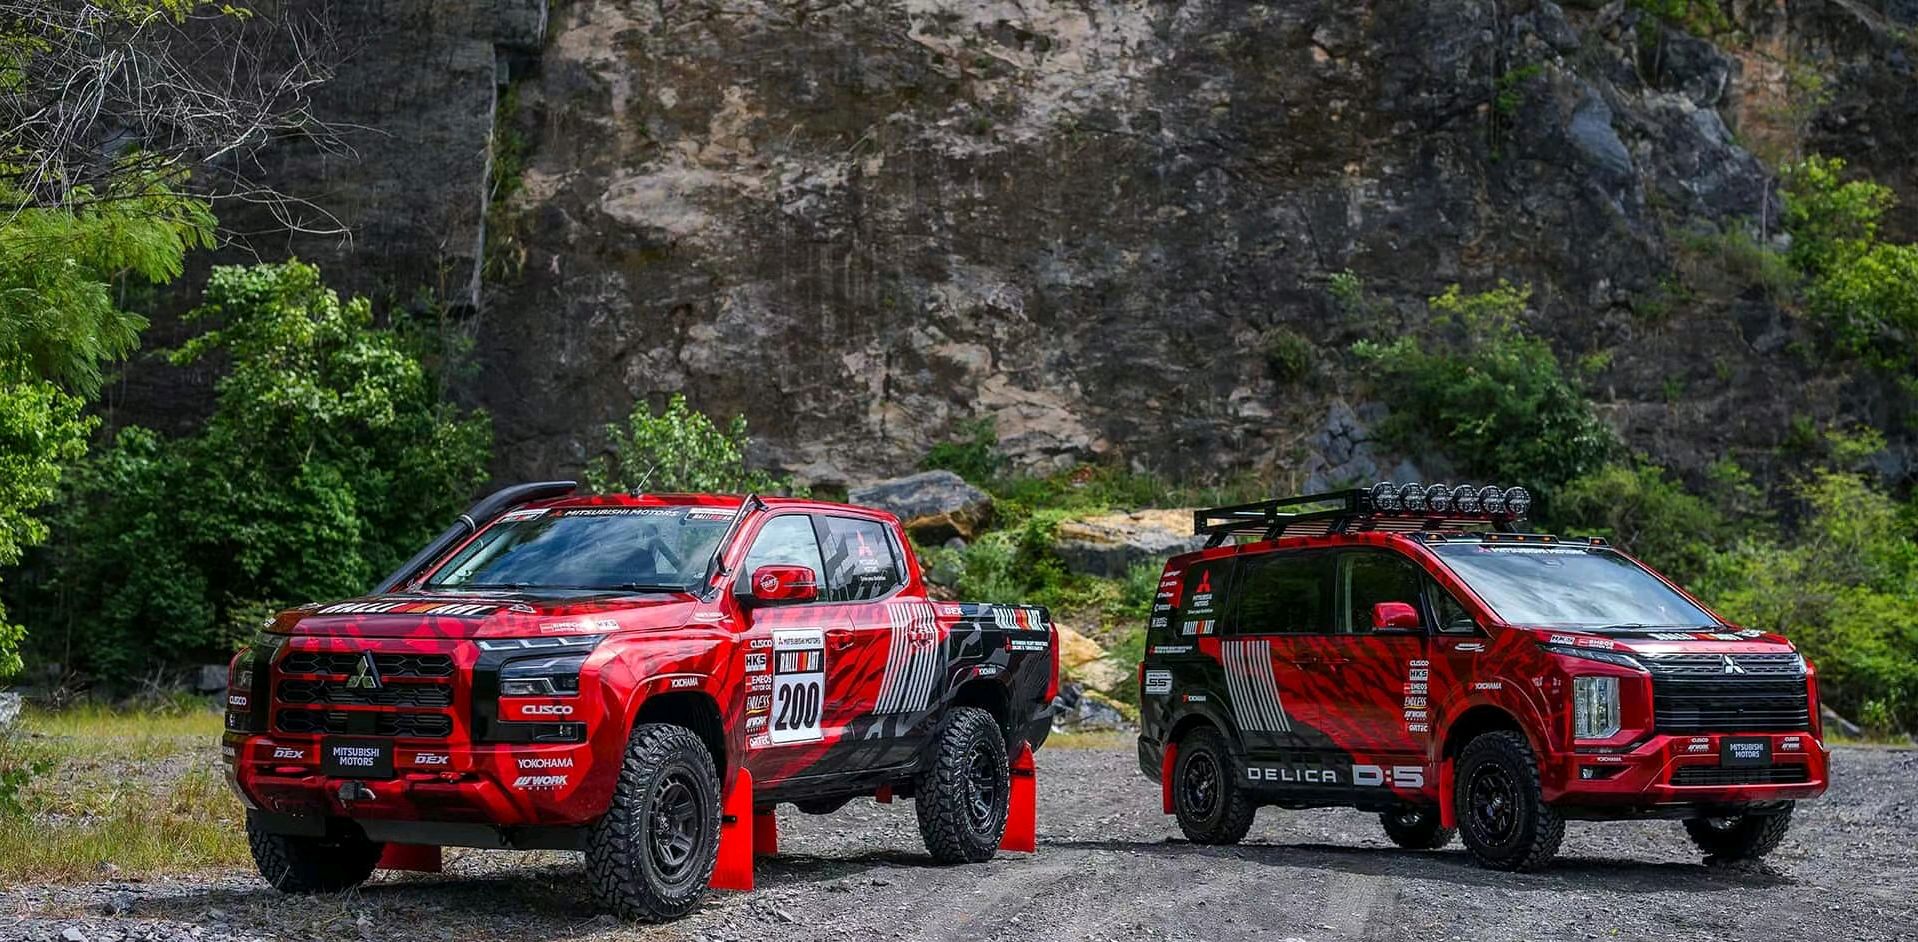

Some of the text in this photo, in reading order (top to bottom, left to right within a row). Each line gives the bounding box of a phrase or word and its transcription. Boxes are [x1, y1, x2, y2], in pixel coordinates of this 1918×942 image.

[564, 508, 680, 517] MITSUBISHI MOTORS
[750, 639, 773, 648] CUSCO
[745, 655, 766, 666] HKS
[752, 674, 772, 684] ENEOS
[1410, 670, 1428, 678] HKS
[671, 676, 699, 688] YOKOHAMA
[521, 705, 574, 715] CUSCO
[774, 681, 820, 731] 200
[333, 747, 380, 757] MITSUBISHI
[1729, 743, 1764, 751] MITSUBISHI
[273, 750, 305, 759] DEX
[414, 755, 449, 764] DEX
[339, 757, 374, 767] MOTORS
[518, 757, 574, 769] YOKOHAMA
[1247, 764, 1424, 788] DELICA D:5
